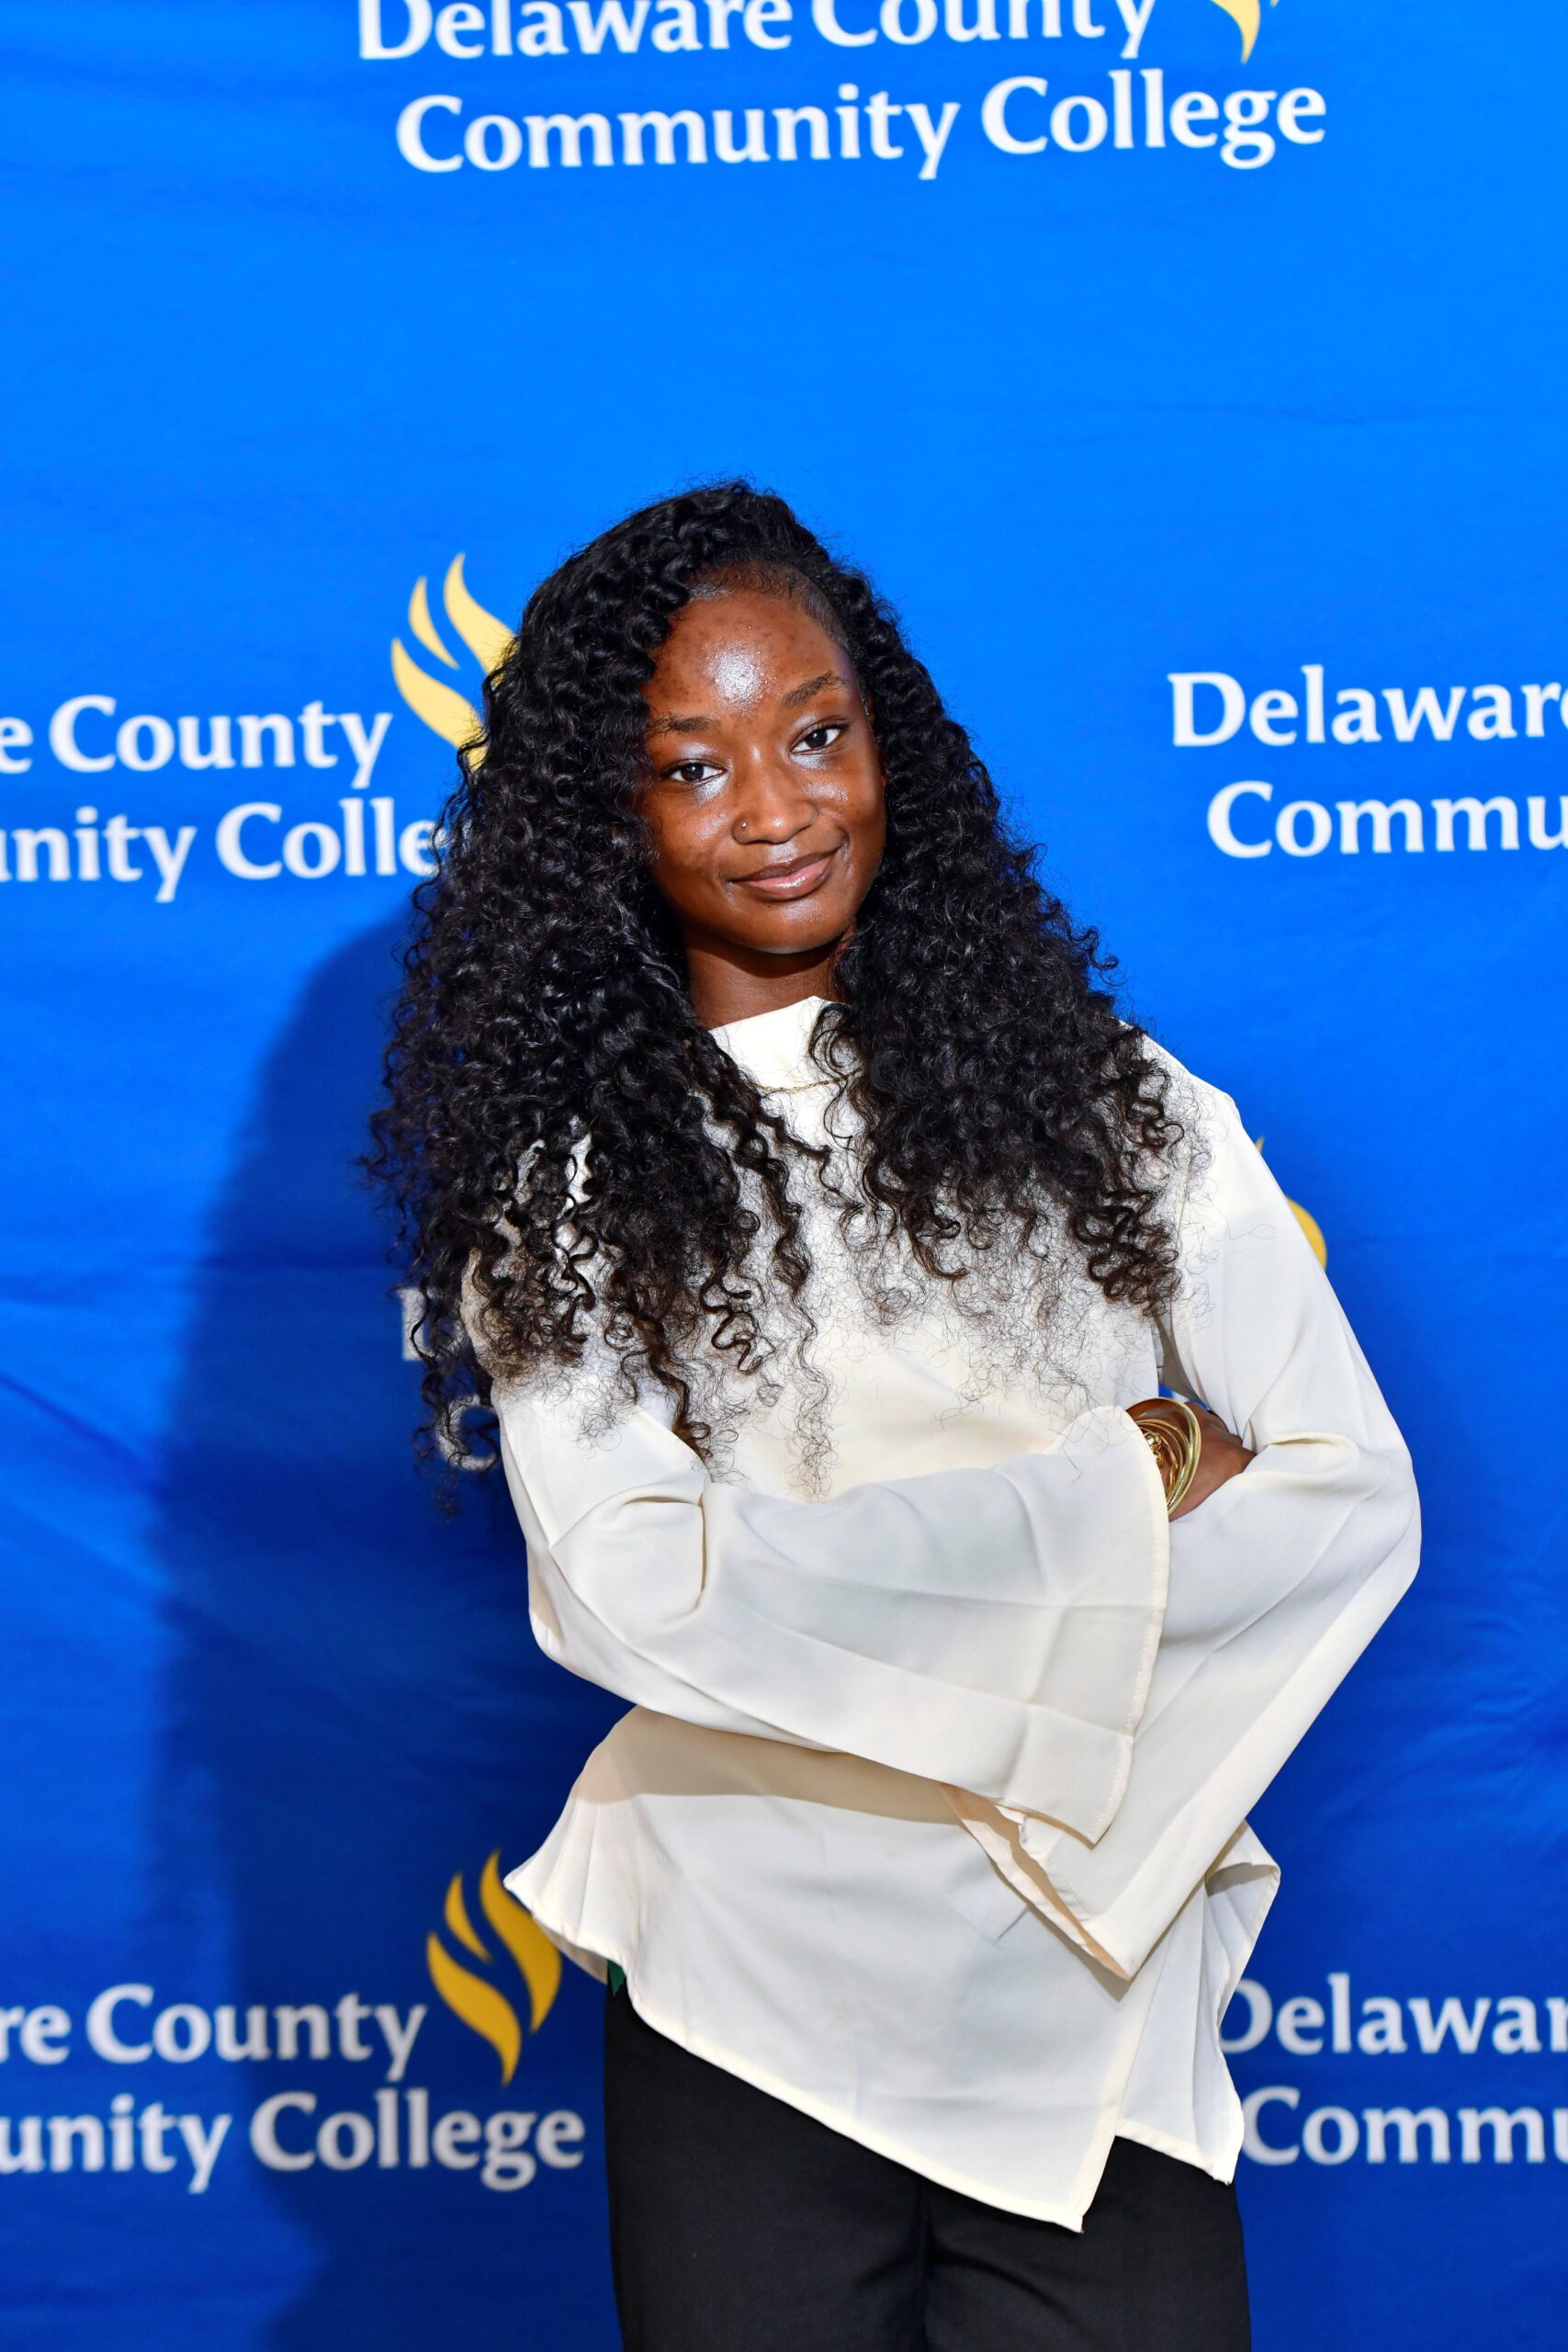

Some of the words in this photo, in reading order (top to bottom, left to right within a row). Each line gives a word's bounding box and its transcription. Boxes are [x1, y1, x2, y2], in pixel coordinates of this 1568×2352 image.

[359, 0, 793, 59] Delaware
[812, 0, 1156, 58] County
[396, 84, 960, 179] Community
[982, 68, 1326, 169] College
[49, 695, 393, 789] County
[1168, 664, 1568, 746] Delawar
[0, 806, 197, 903] nity
[86, 1984, 427, 2082] County
[250, 2087, 585, 2191] College
[1242, 2086, 1568, 2165] Comm
